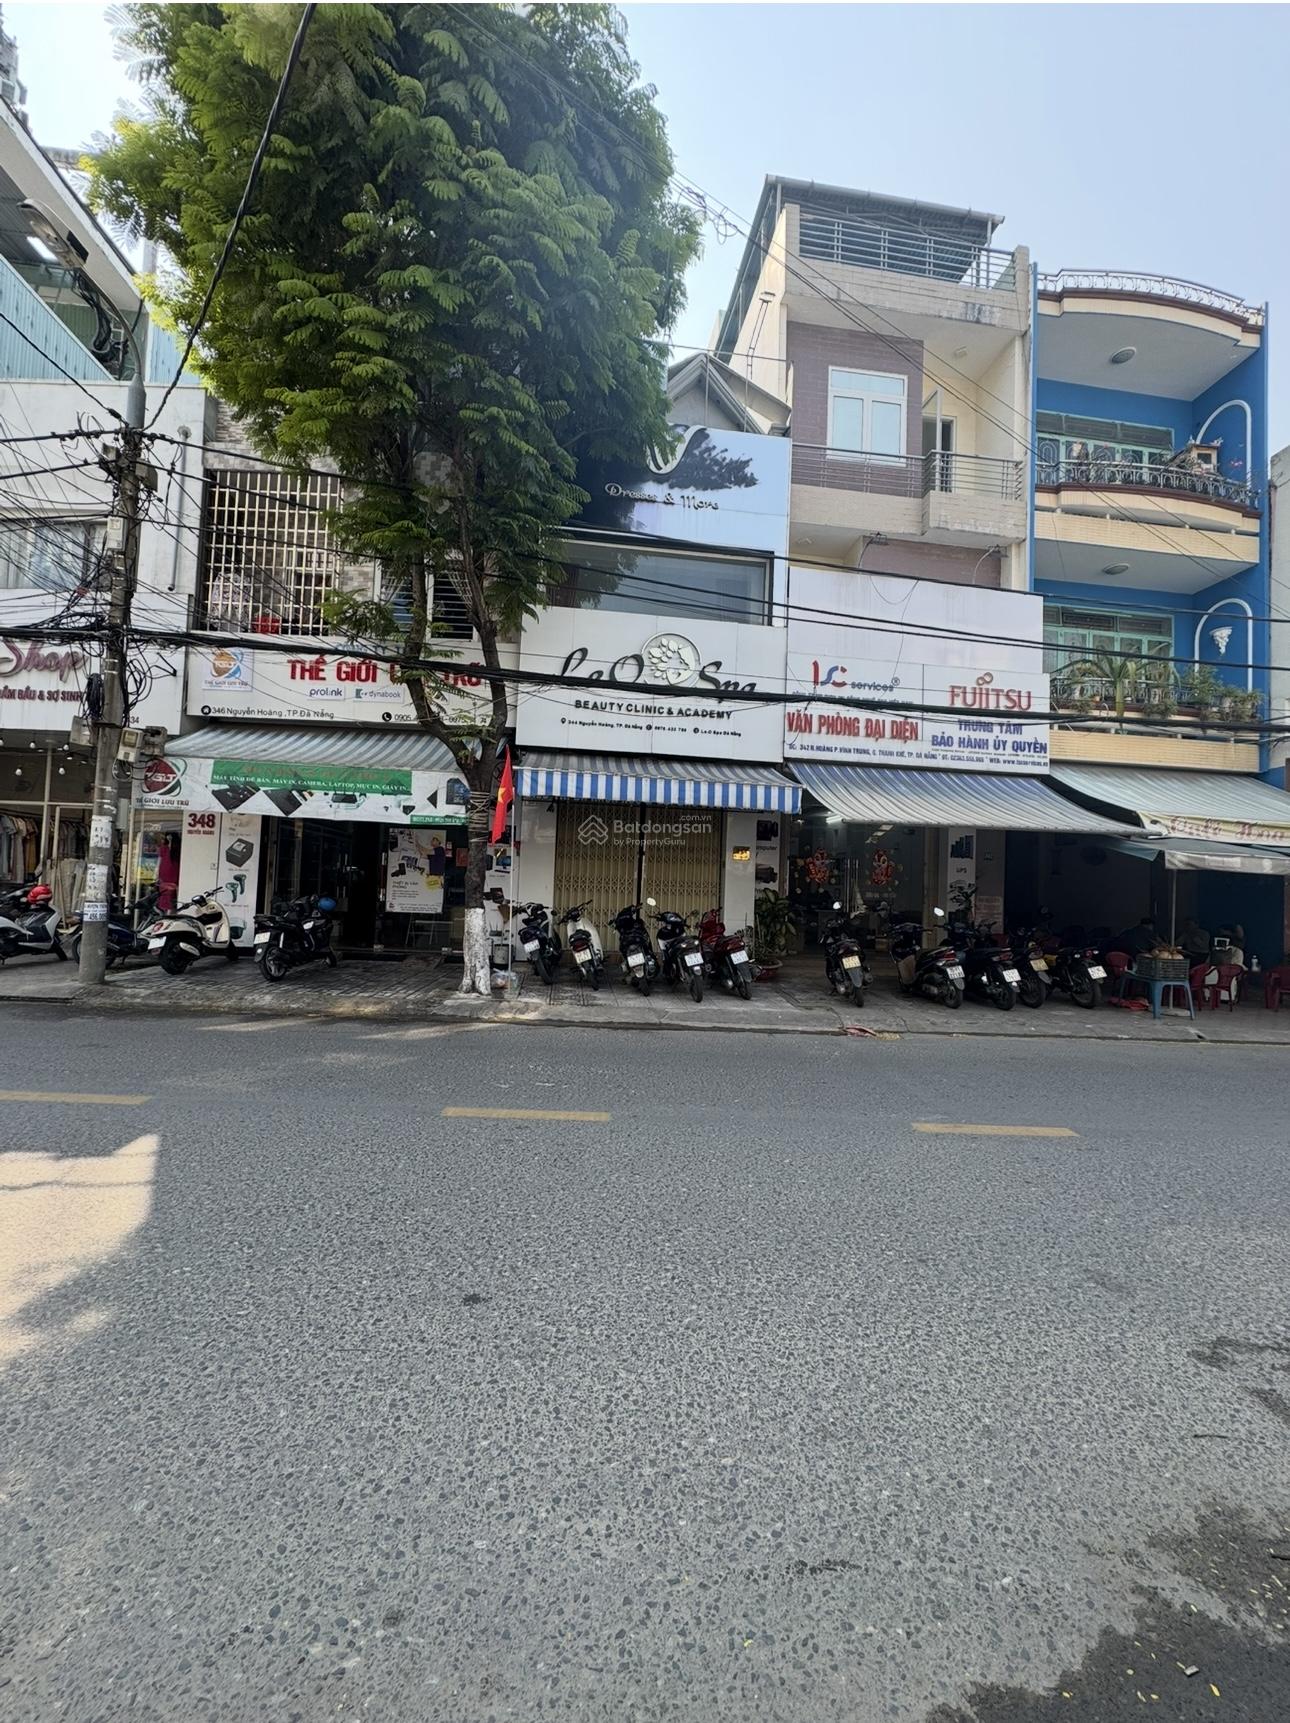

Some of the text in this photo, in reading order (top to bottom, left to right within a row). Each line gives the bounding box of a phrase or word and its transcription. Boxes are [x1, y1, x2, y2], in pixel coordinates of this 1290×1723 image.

[664, 493, 675, 505] &
[38, 689, 45, 700] &
[309, 688, 343, 698] prolink
[369, 690, 401, 699] dynabook
[949, 677, 1032, 710] FUJITSU
[212, 706, 226, 714] 346
[227, 707, 256, 717] Nguyễn
[575, 700, 732, 720] BEAUTY CLINIC & ACADEMY
[787, 709, 919, 744] VĂN PHÒNG ĐẠI DIỆN
[931, 731, 1048, 754] BẢO HÀNH ỦY QUYỀN
[188, 813, 216, 829] 348
